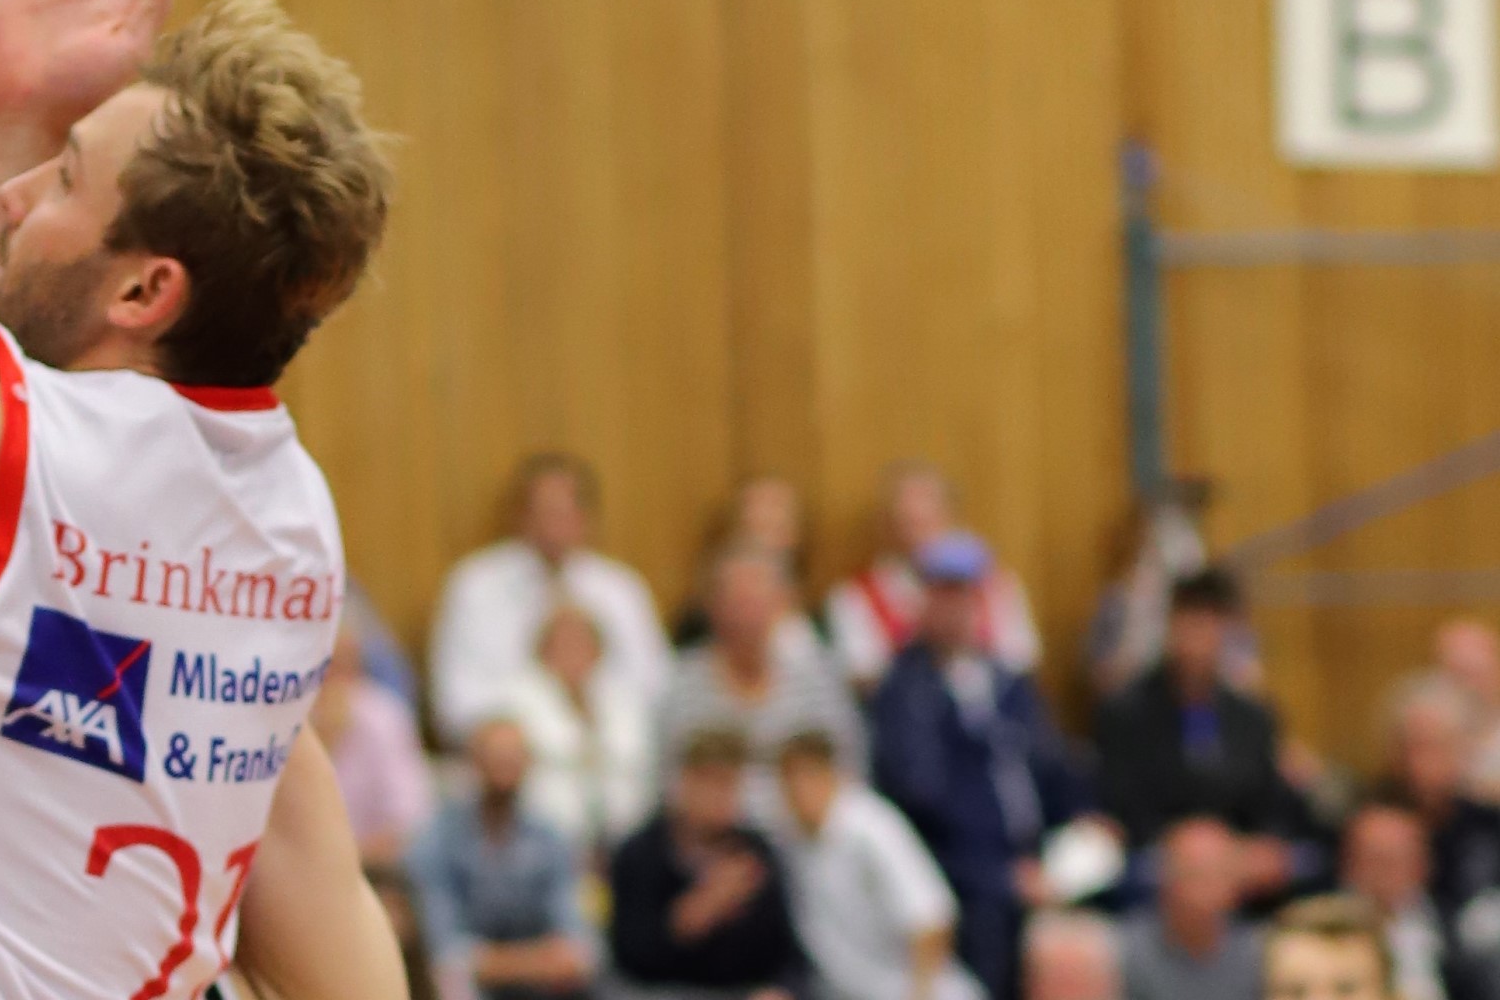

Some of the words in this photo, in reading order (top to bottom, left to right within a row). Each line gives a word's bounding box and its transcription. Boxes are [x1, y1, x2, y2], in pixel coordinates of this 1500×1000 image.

[169, 651, 331, 704] Mladen
[3, 689, 124, 766] AXA
[164, 732, 197, 781] &
